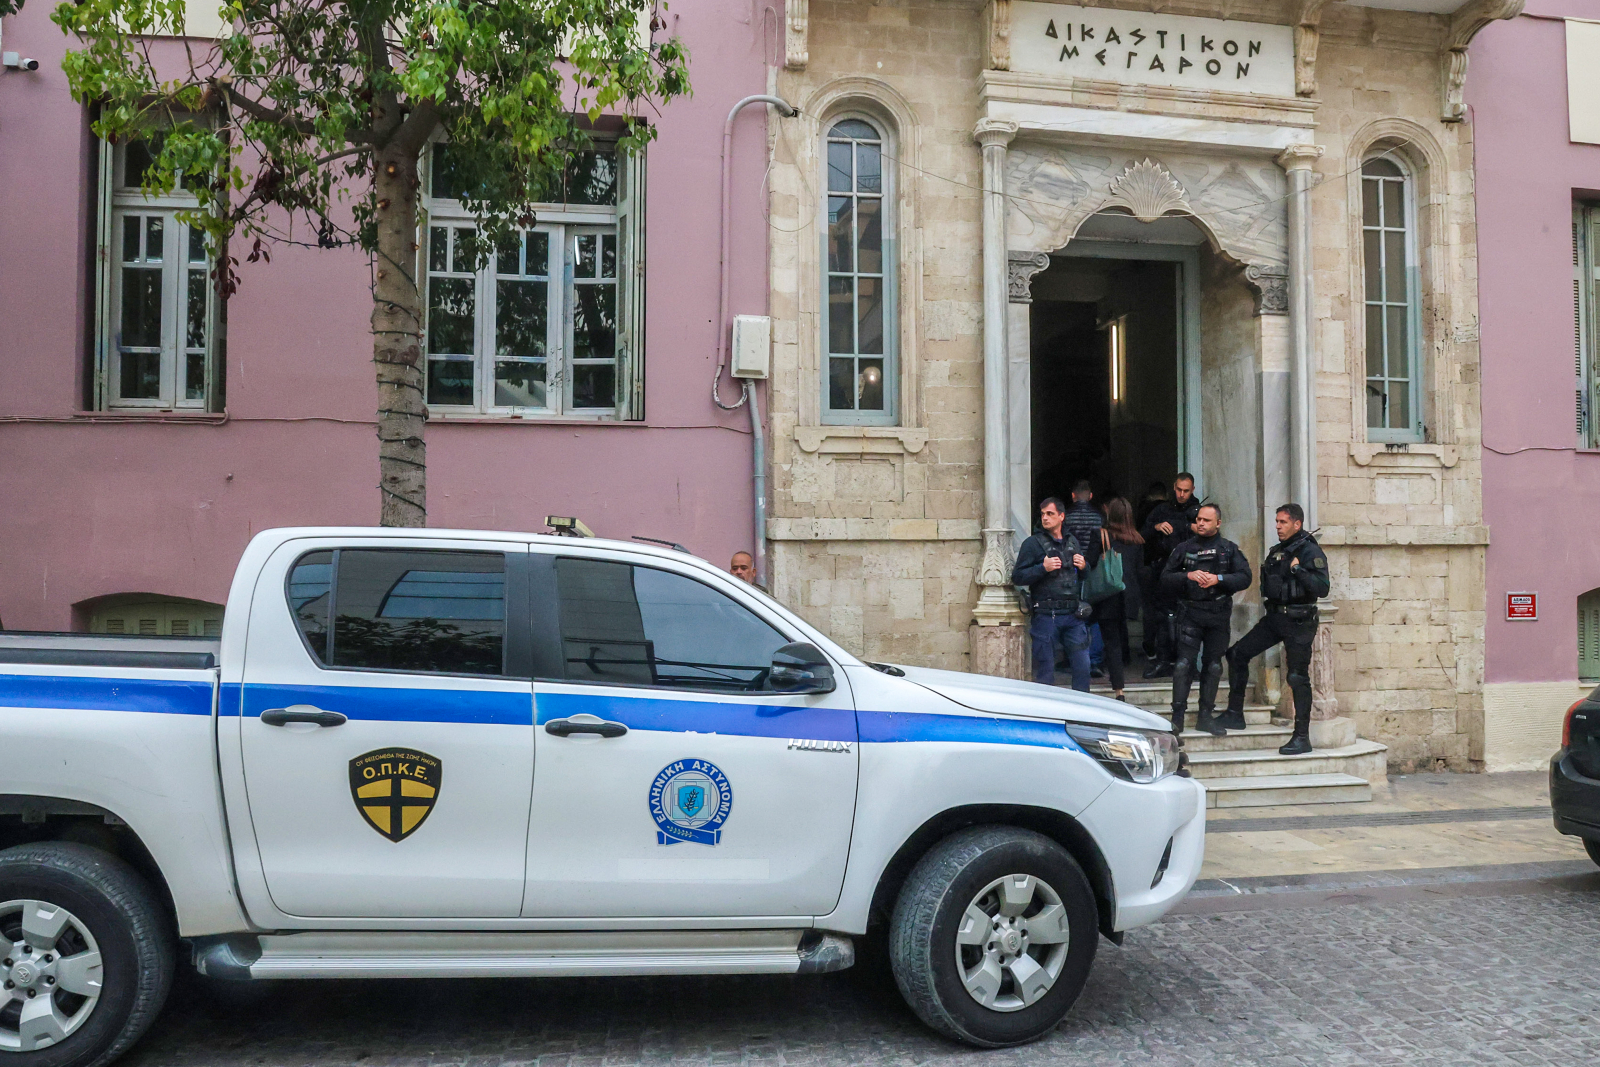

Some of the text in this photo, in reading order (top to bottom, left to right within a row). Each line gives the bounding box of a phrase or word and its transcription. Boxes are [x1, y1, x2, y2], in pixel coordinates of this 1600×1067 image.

[1045, 19, 1261, 57] ΔΙΚΑΣΤΙΚΟΝ
[1059, 45, 1250, 79] ΜΕΓΑΡΟΝ
[787, 738, 852, 753] HILUX
[363, 762, 428, 781] Ο.Π.Κ.Ε.
[650, 760, 731, 824] ΕΛΛΗΝΙΚΗ ΑΣΤΥΝΟΜΙΑ
